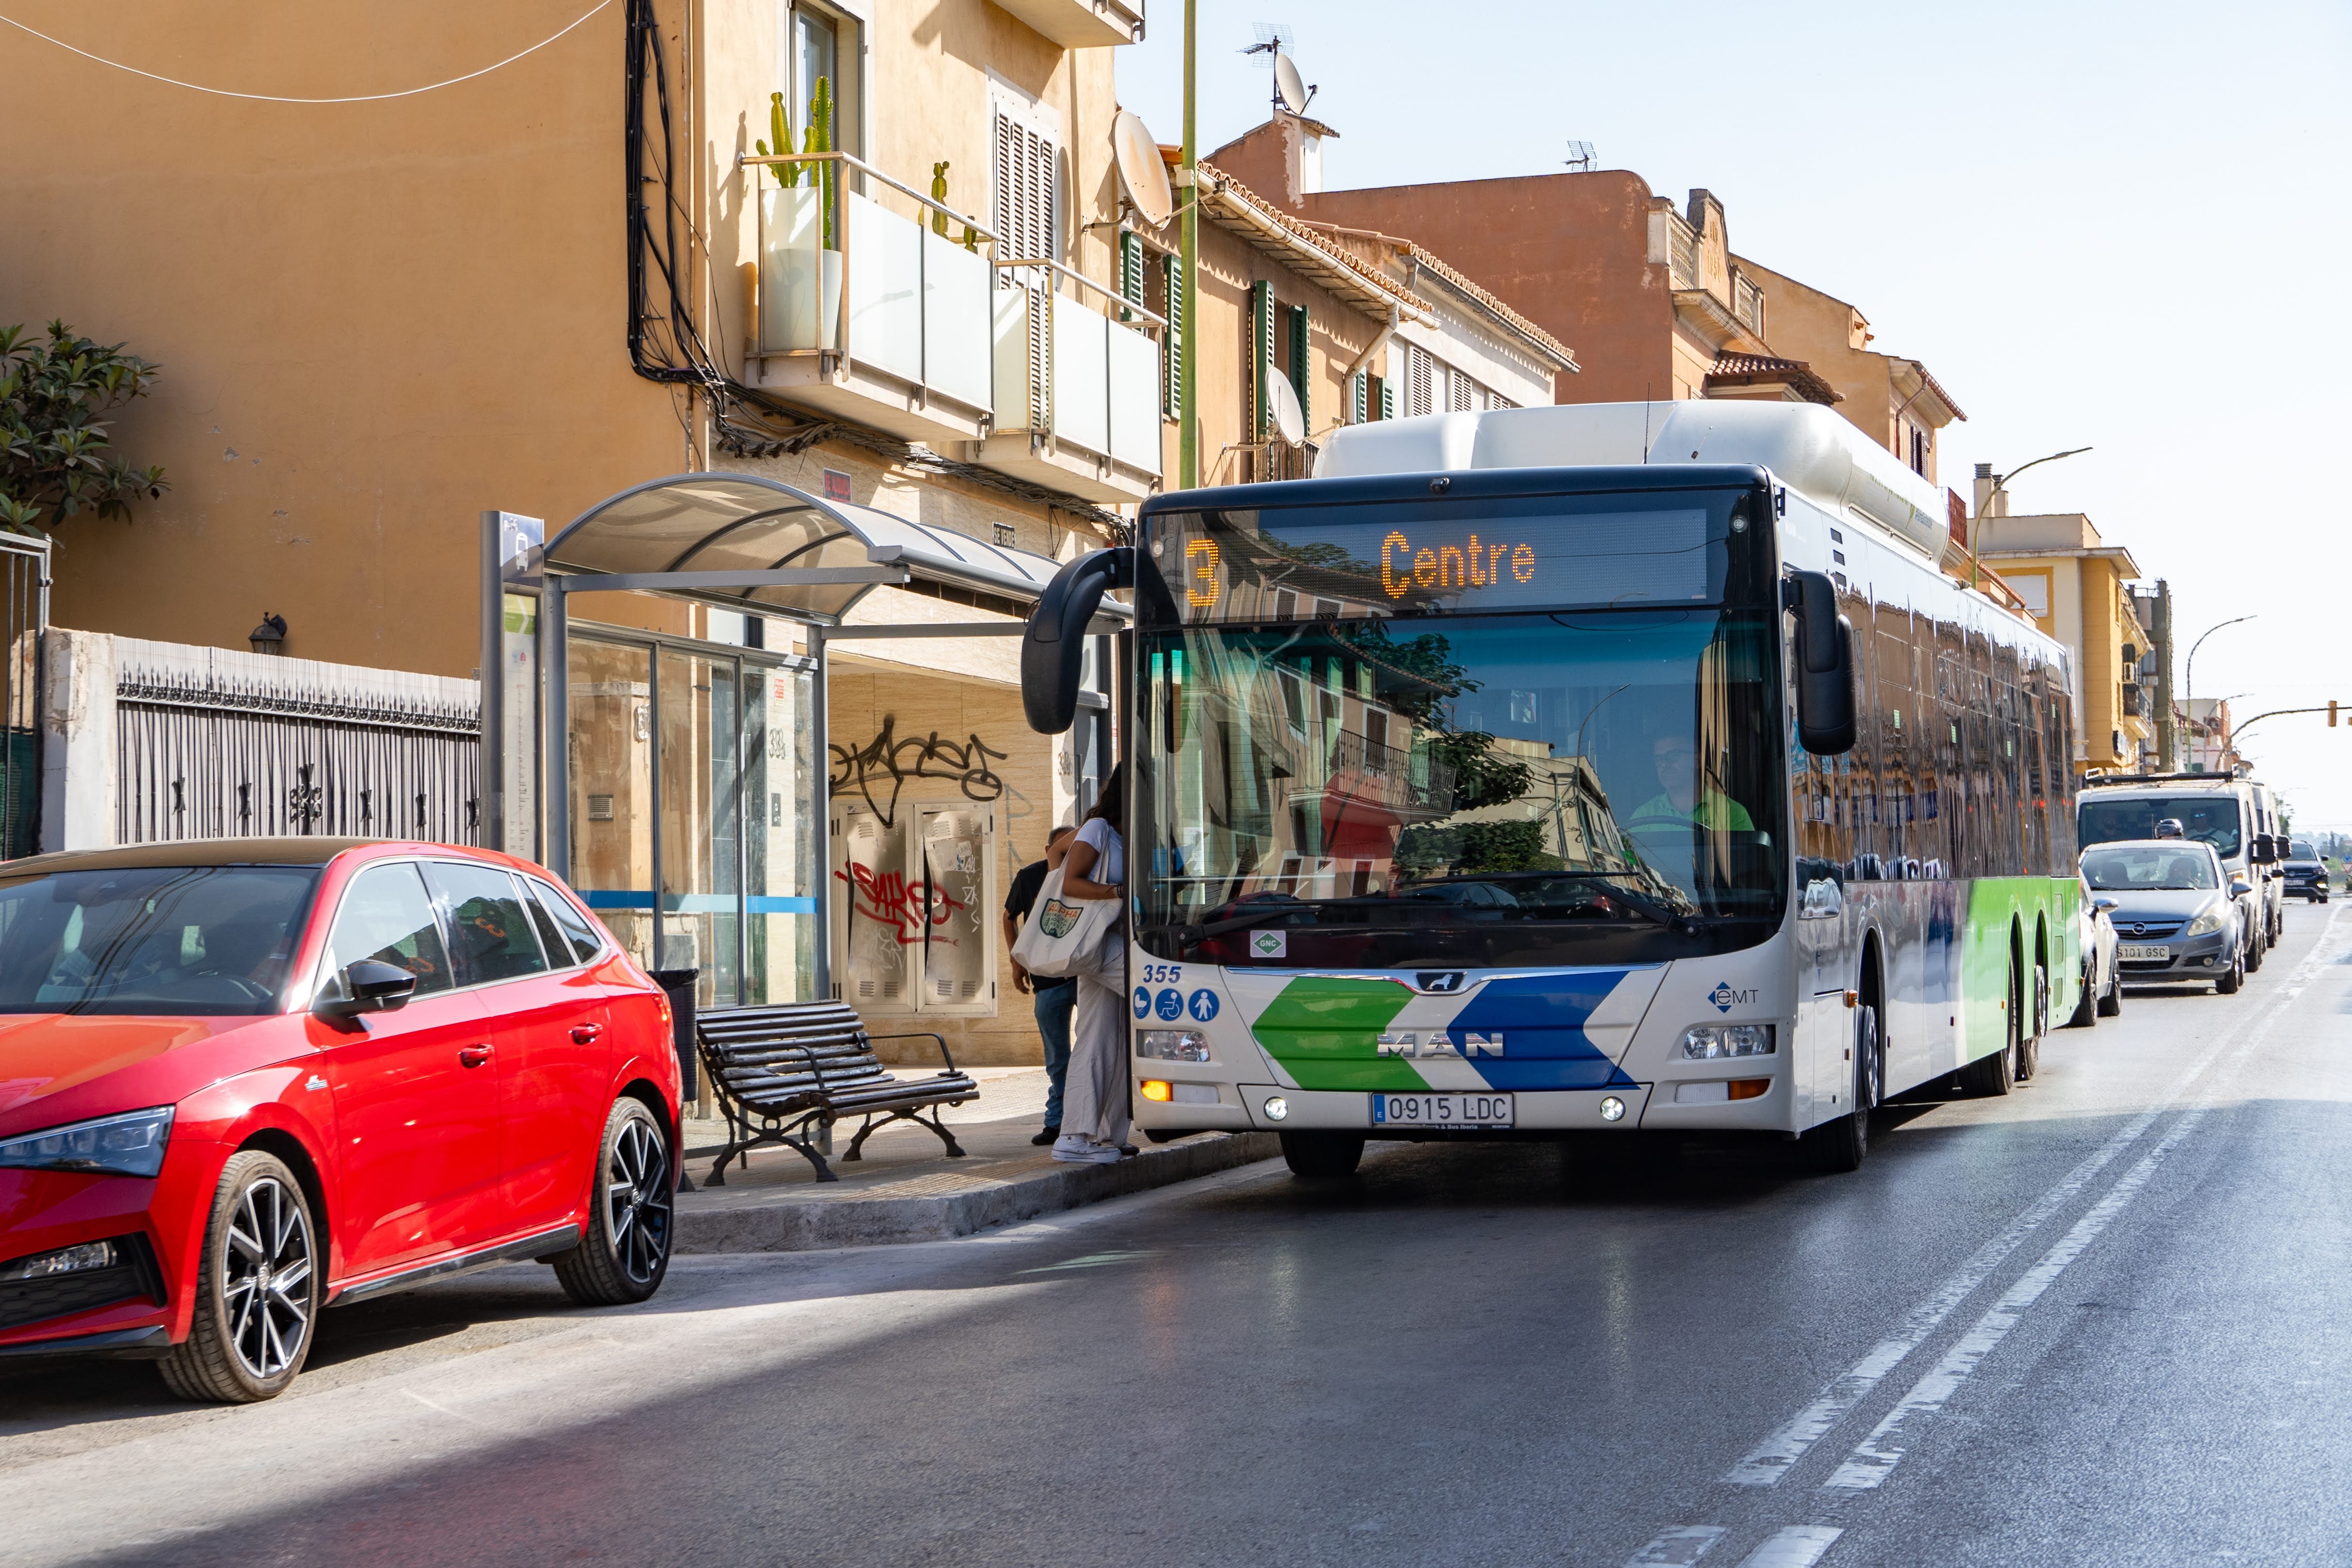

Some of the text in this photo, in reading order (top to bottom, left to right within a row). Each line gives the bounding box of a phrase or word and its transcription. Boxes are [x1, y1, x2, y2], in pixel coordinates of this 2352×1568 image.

[994, 526, 1015, 547] SE VENDE
[1186, 539, 1219, 606] 3
[1382, 532, 1534, 599] Centre
[1048, 903, 1078, 918] ALPHA
[2146, 948, 2165, 957] GSC
[1143, 964, 1182, 983] 355
[1377, 1033, 1504, 1058] MAN
[1389, 1098, 1506, 1120] 0915 LDC
